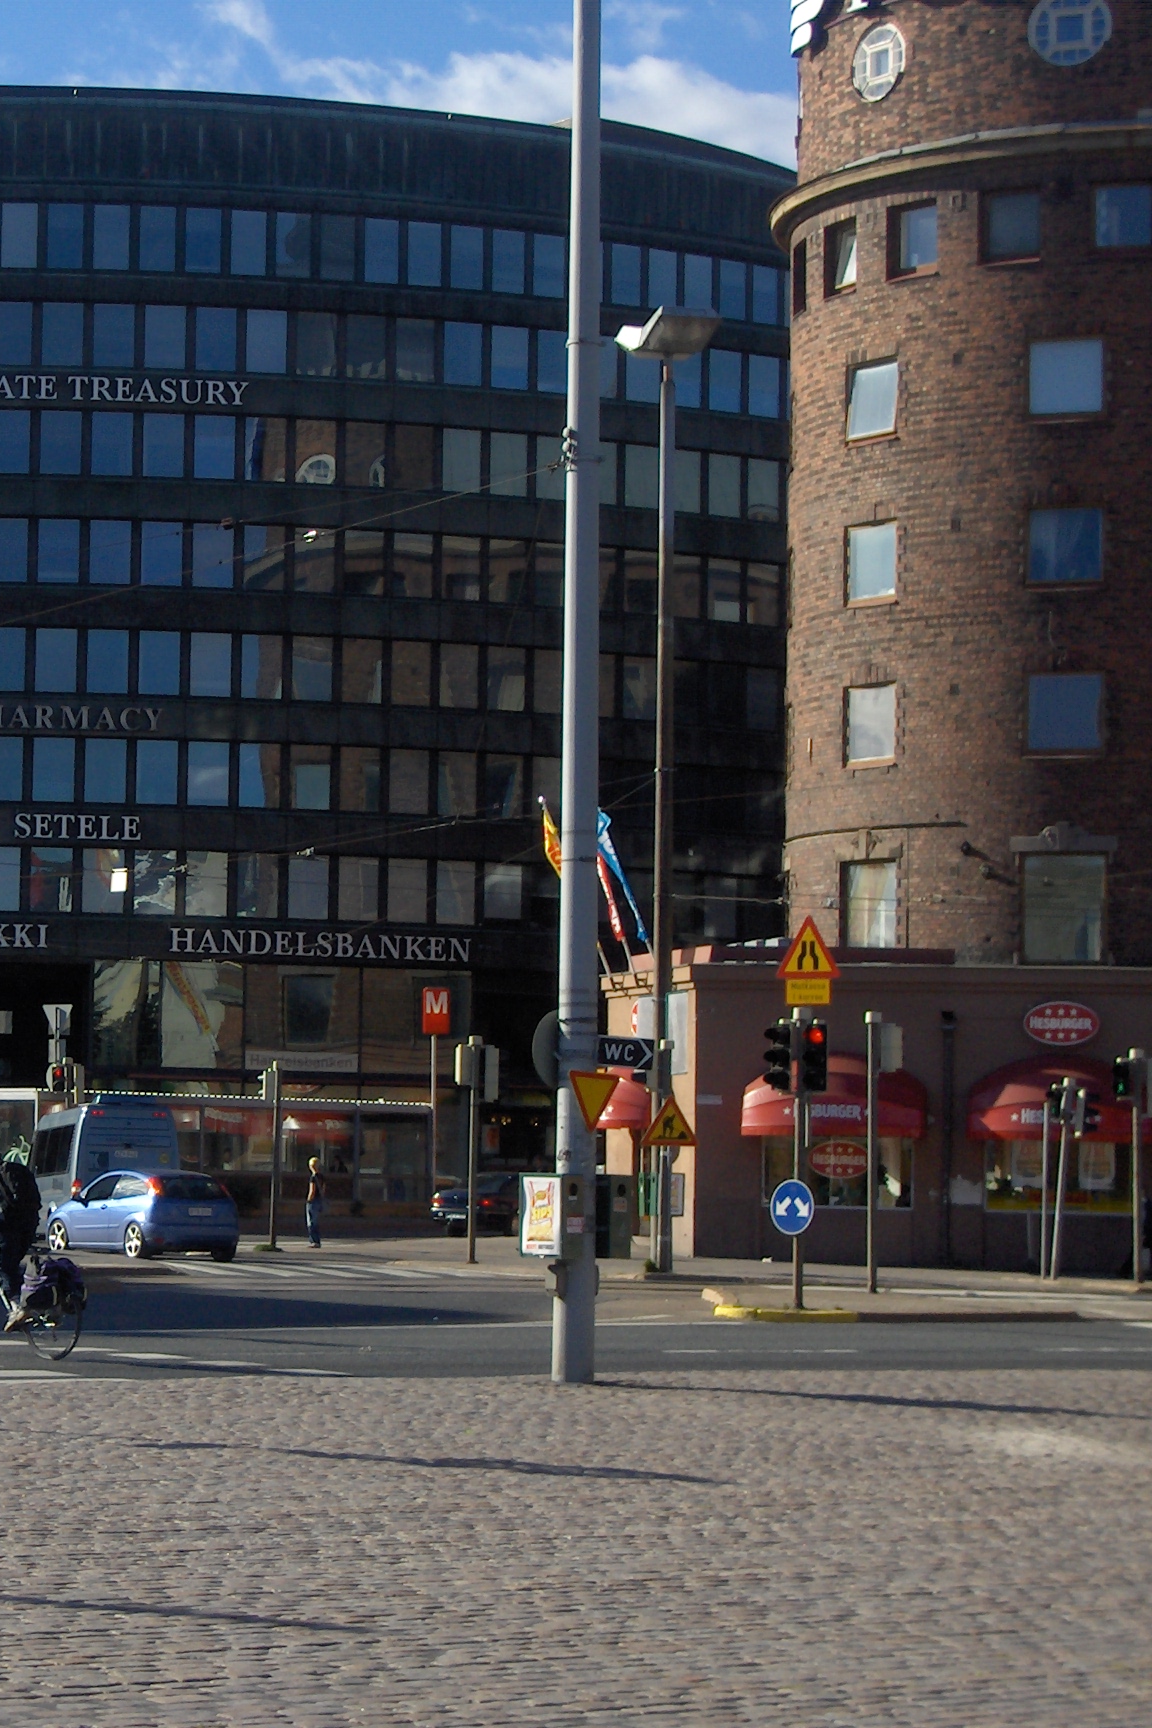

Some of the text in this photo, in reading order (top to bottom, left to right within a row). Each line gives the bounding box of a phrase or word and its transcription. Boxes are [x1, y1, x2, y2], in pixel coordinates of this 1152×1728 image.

[68, 375, 249, 406] TREASURY
[13, 812, 142, 842] SETELE
[169, 927, 472, 963] HANDELSBANKEN
[425, 991, 448, 1014] M
[1029, 1016, 1092, 1031] HESBURGER
[604, 1042, 635, 1062] WC
[793, 1103, 861, 1121] SBURGER
[812, 1152, 867, 1166] HESBURGER
